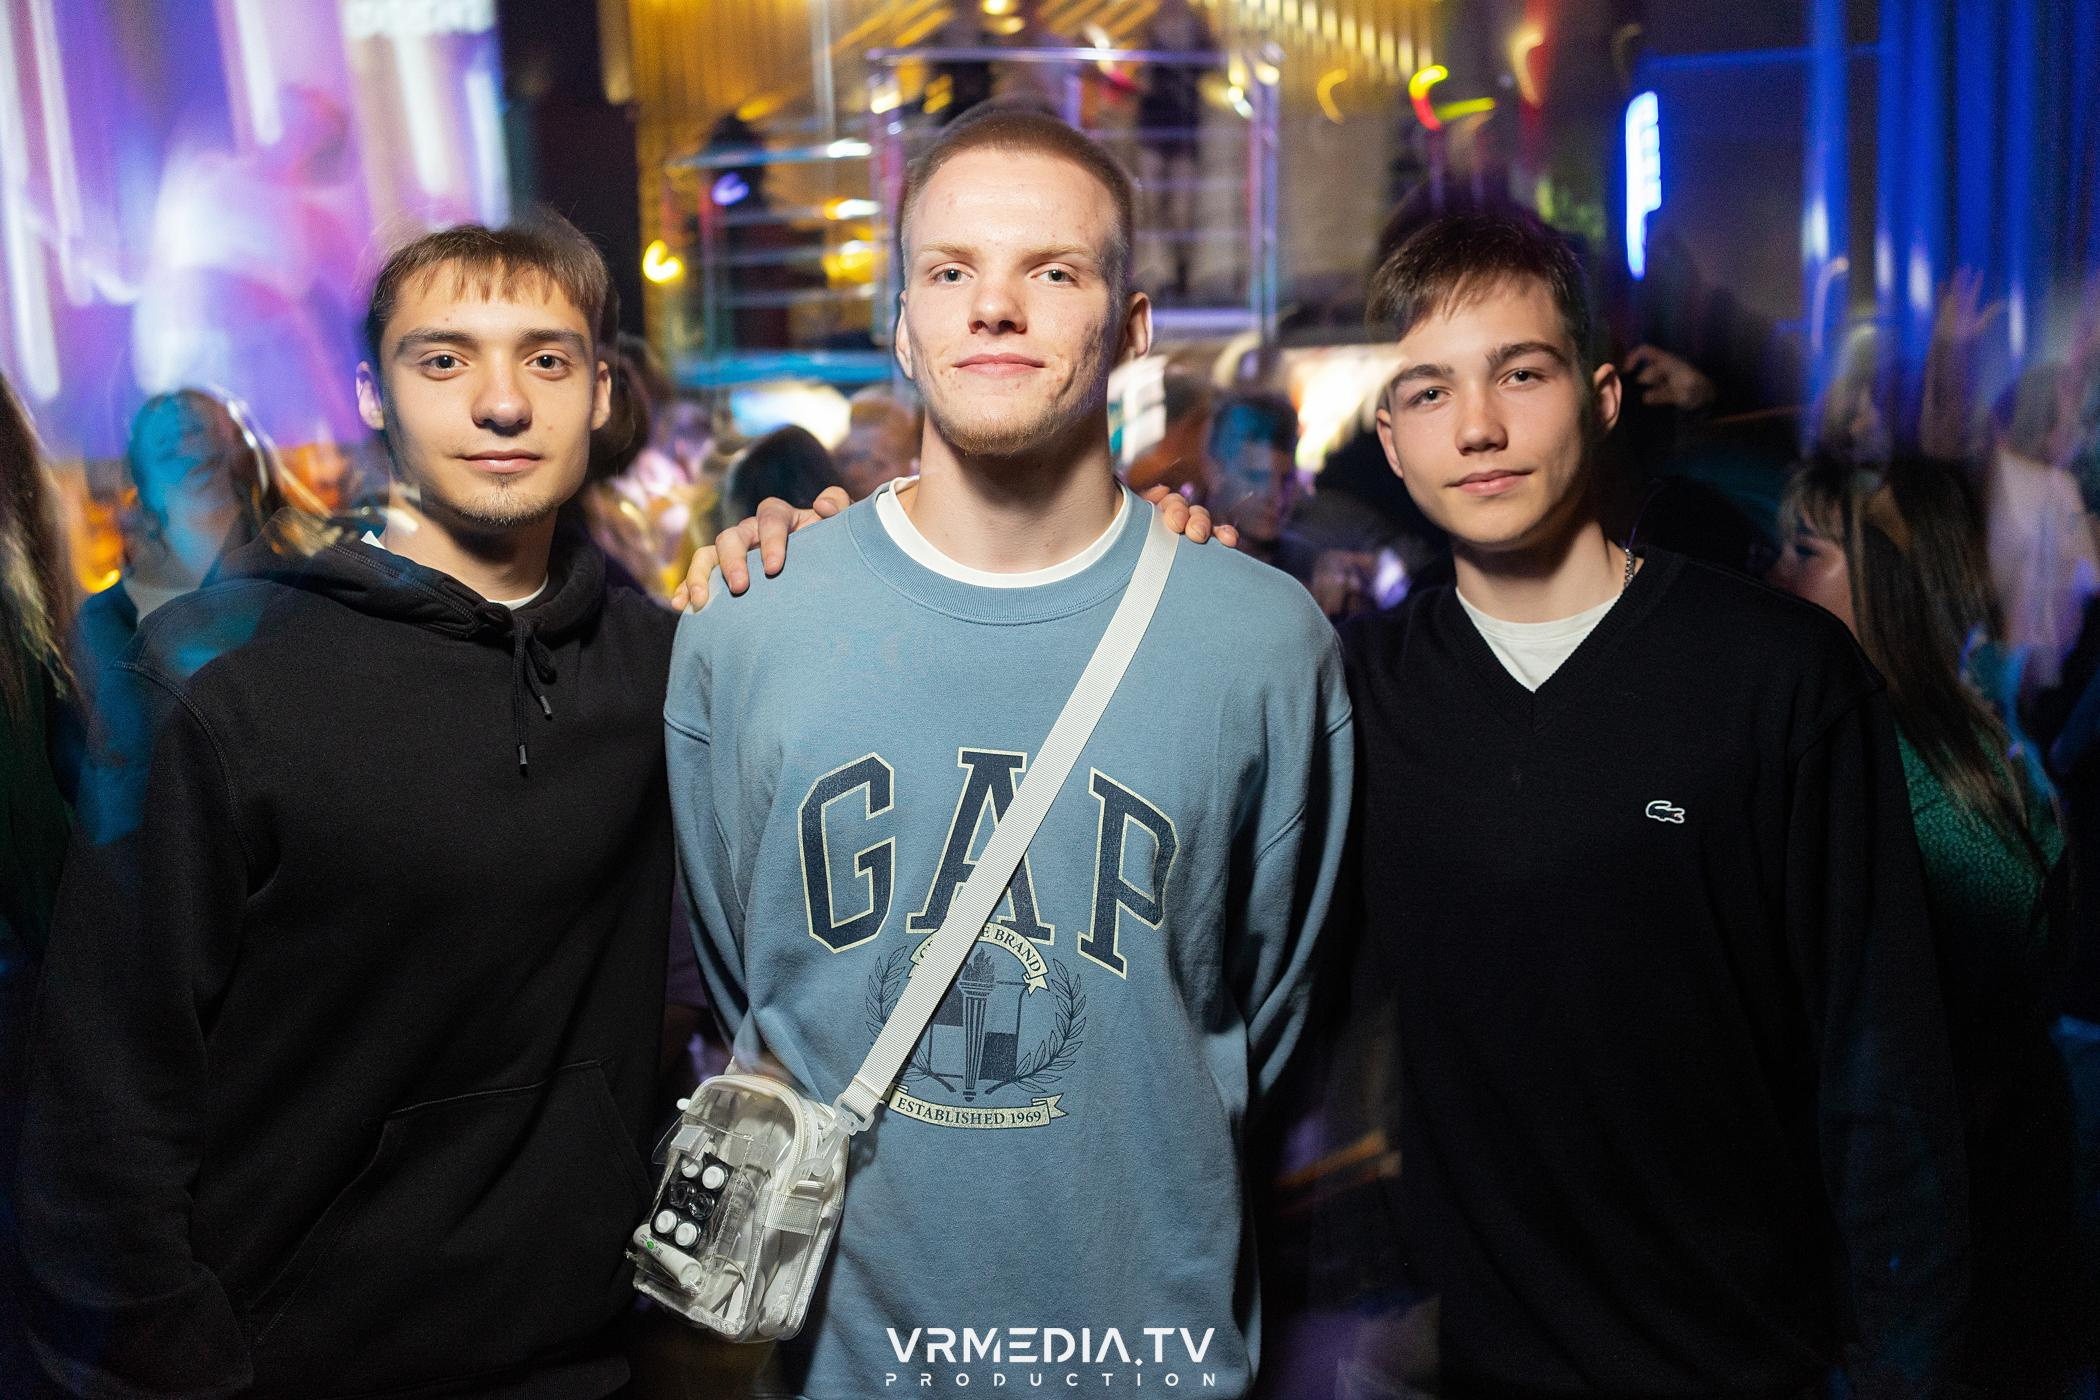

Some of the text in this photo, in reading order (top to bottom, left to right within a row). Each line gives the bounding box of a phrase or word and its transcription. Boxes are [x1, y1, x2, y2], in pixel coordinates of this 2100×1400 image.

[797, 746, 1180, 980] GAP
[994, 928, 1041, 972] BRAND
[896, 1097, 1041, 1125] ESTABLISHED 1969
